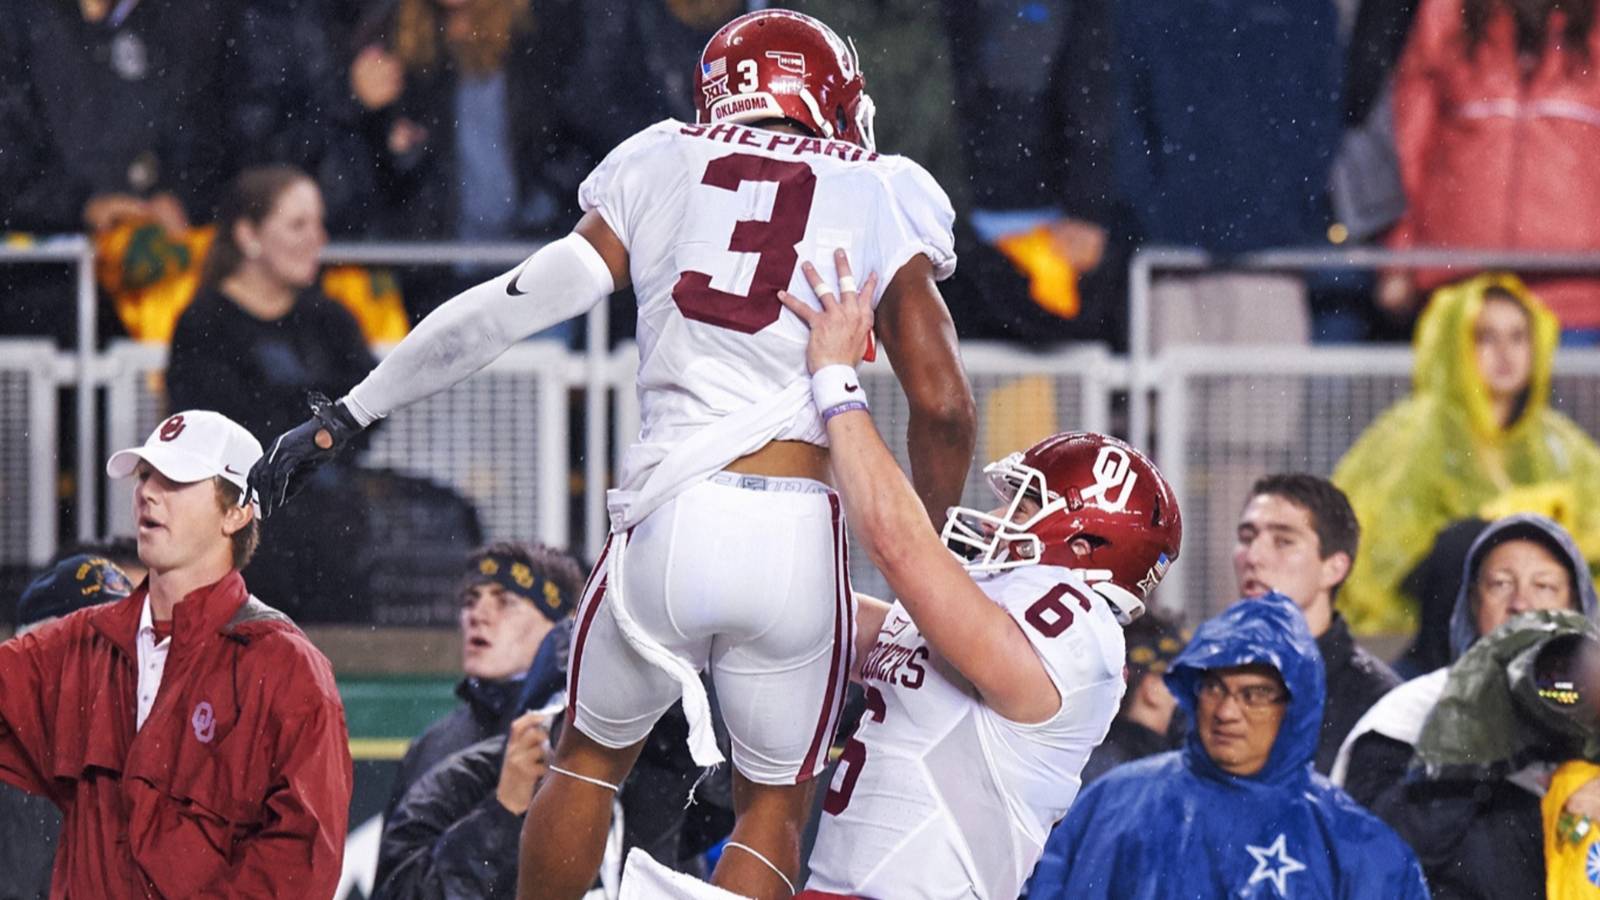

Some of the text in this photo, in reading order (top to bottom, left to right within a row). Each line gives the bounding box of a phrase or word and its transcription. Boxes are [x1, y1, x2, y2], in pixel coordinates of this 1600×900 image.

[736, 58, 759, 93] 3
[714, 97, 769, 119] OKLAHOMA
[671, 152, 817, 335] 3
[1088, 447, 1138, 512] OU
[1024, 582, 1092, 638] 6
[822, 685, 887, 817] 6
